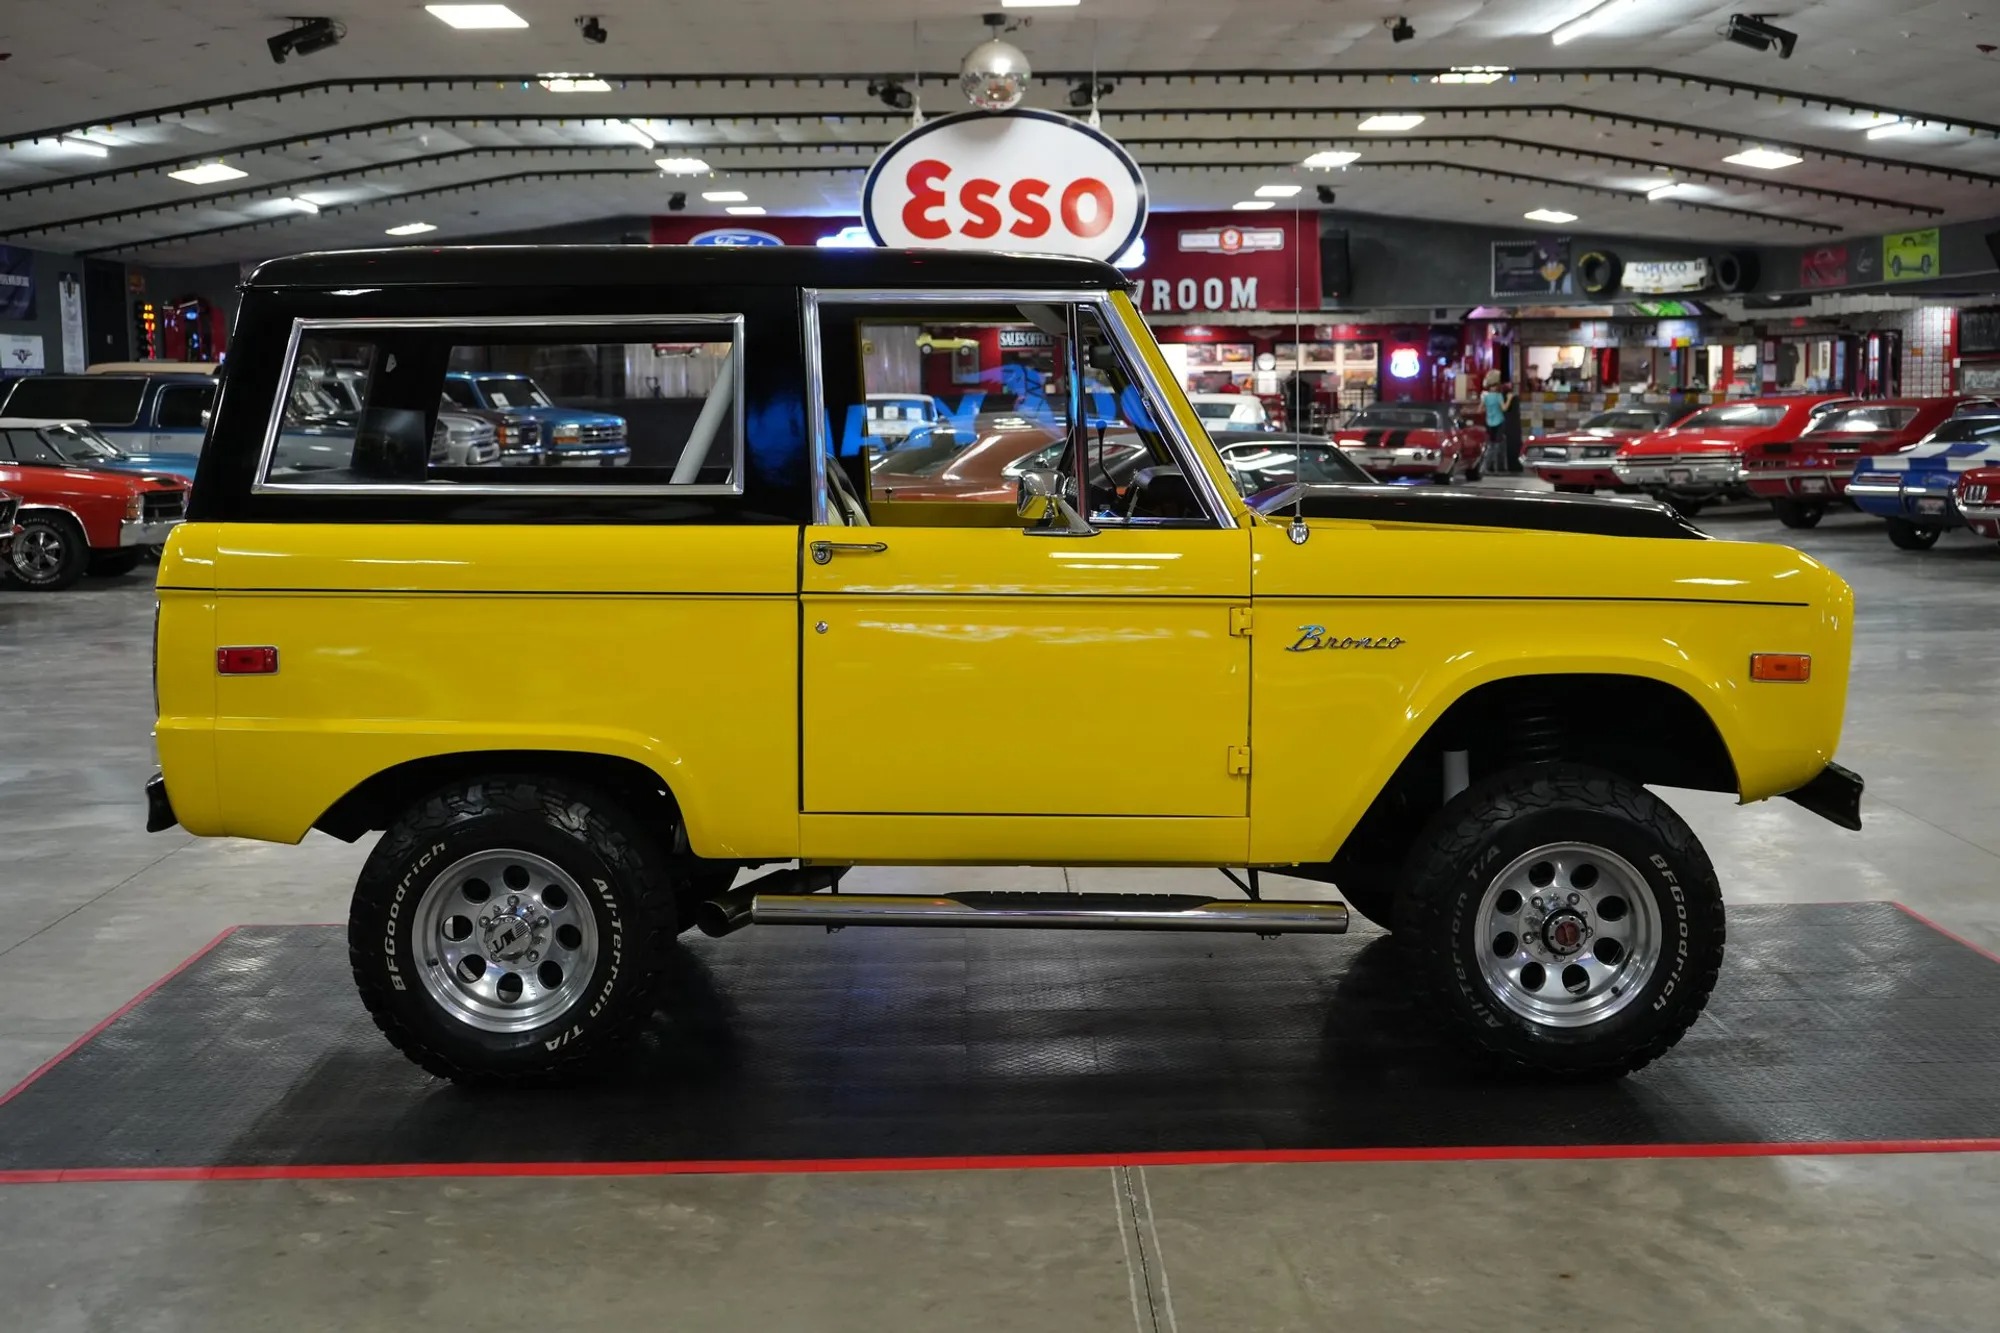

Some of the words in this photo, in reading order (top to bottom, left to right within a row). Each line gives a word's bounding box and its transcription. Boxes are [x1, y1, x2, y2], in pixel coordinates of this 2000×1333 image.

[1000, 331, 1026, 346] SALES
[1285, 624, 1406, 652] Bronco
[1468, 846, 1501, 880] T/A
[384, 842, 446, 991] BFGoodrich
[1650, 853, 1689, 1011] BFGoodrich
[588, 877, 622, 1018] All-Terrain
[544, 1024, 584, 1052] T/A
